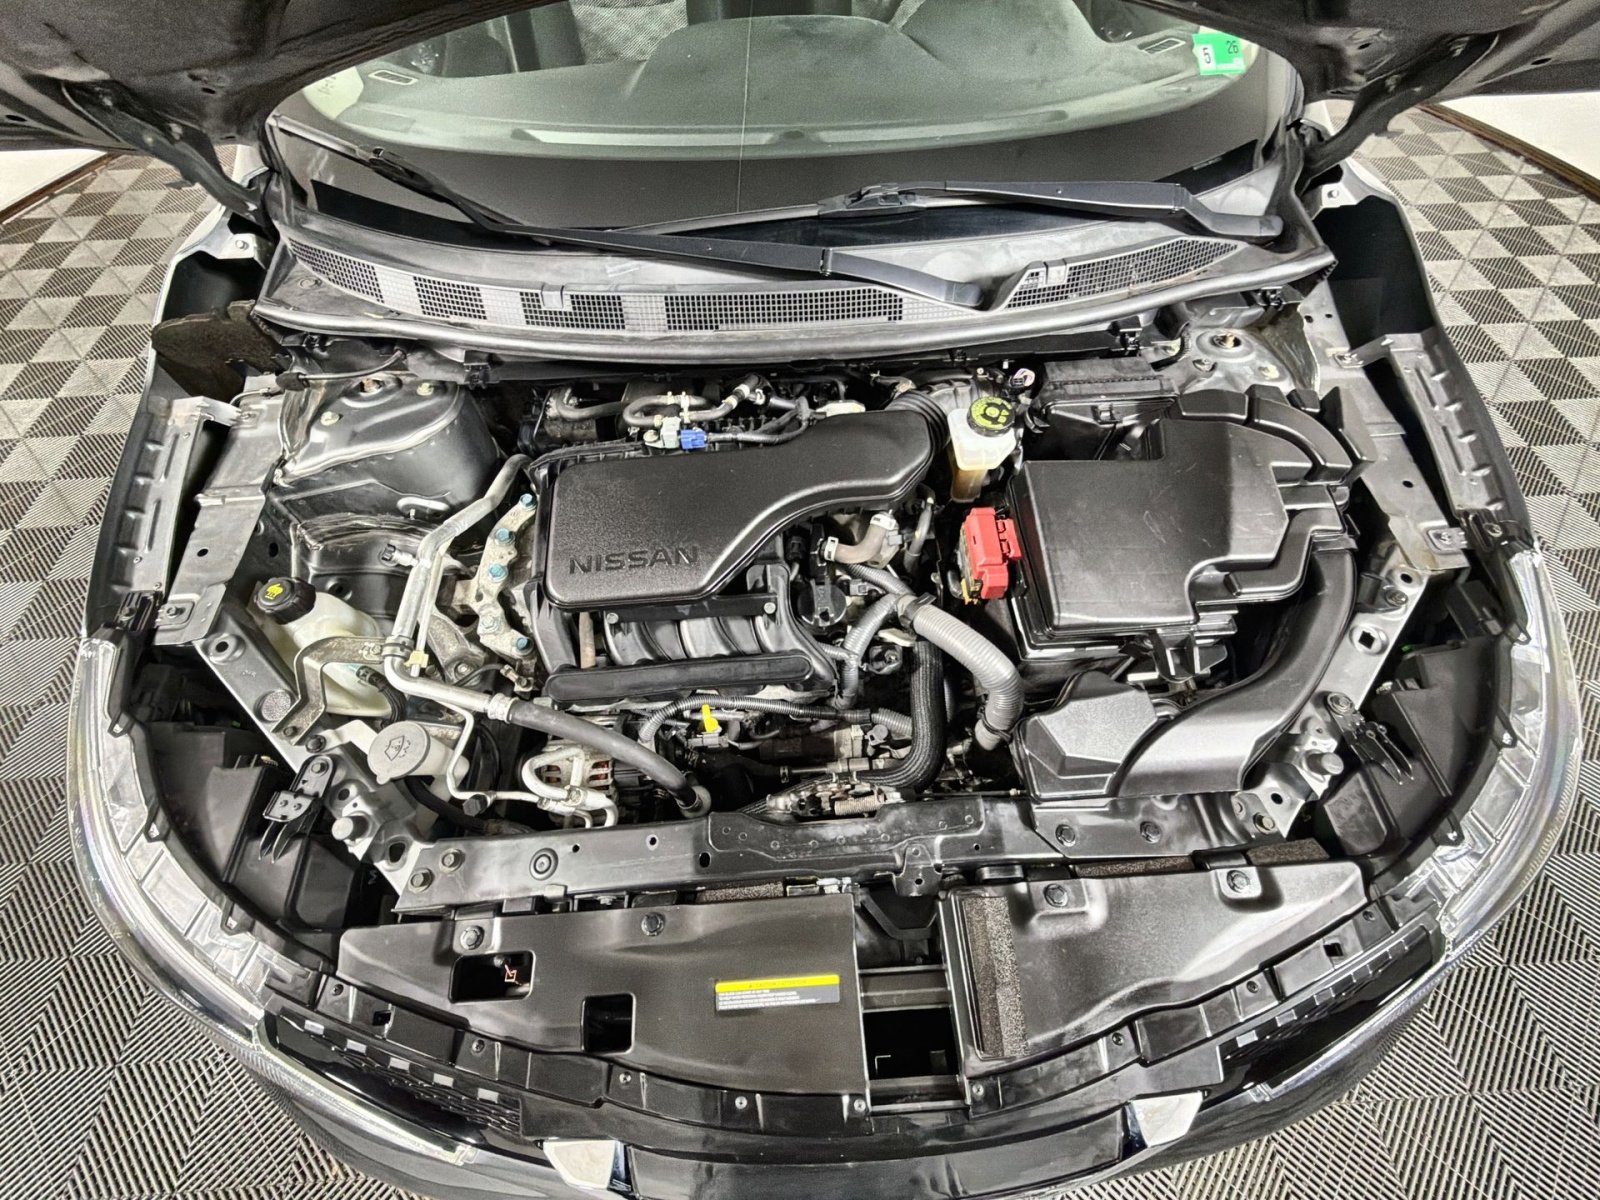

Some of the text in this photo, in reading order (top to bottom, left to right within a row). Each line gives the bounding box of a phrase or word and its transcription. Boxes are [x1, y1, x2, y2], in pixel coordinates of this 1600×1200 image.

[1202, 40, 1240, 64] 5 26
[569, 545, 699, 575] NISSAN
